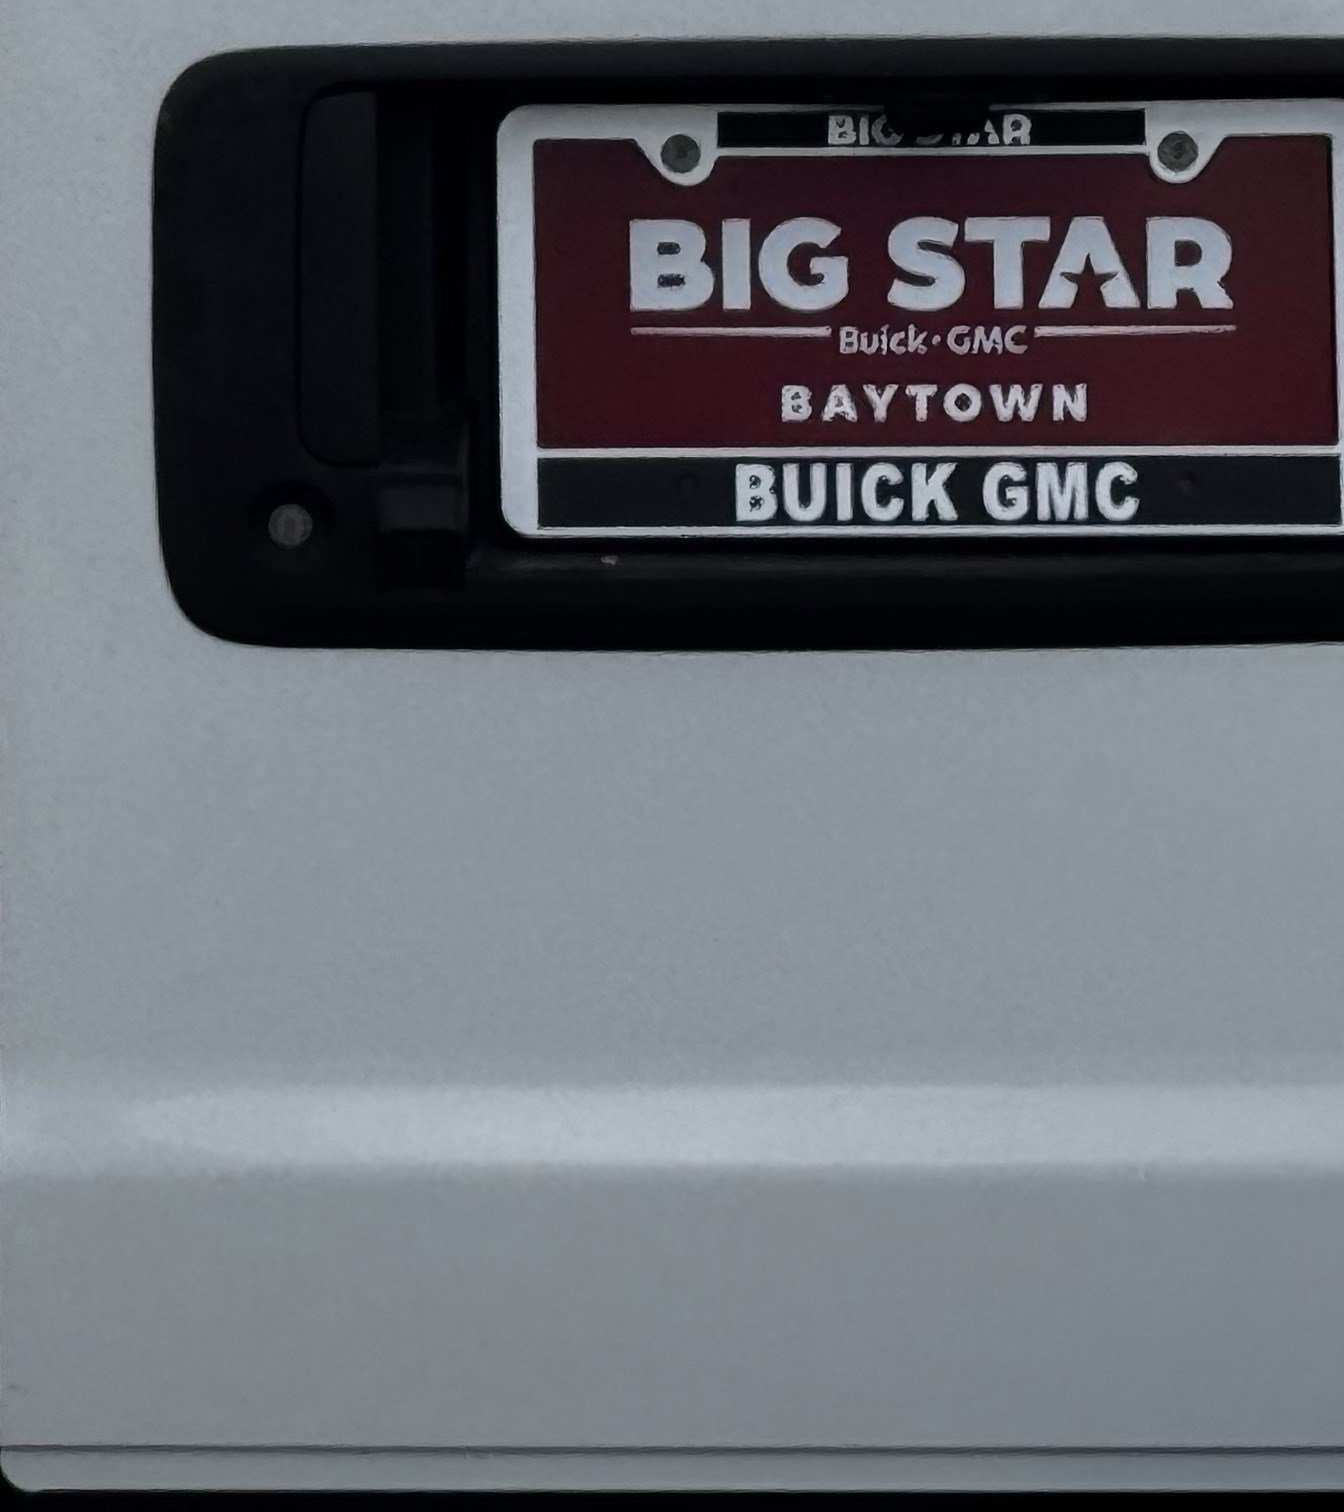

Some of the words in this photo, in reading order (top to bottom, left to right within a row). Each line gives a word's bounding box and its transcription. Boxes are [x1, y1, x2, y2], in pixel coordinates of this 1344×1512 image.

[629, 216, 849, 311] BIG
[887, 215, 1234, 312] STAR
[781, 383, 1087, 423] BAYTOWN
[735, 462, 959, 522] BUICK
[982, 461, 1140, 521] GMC
